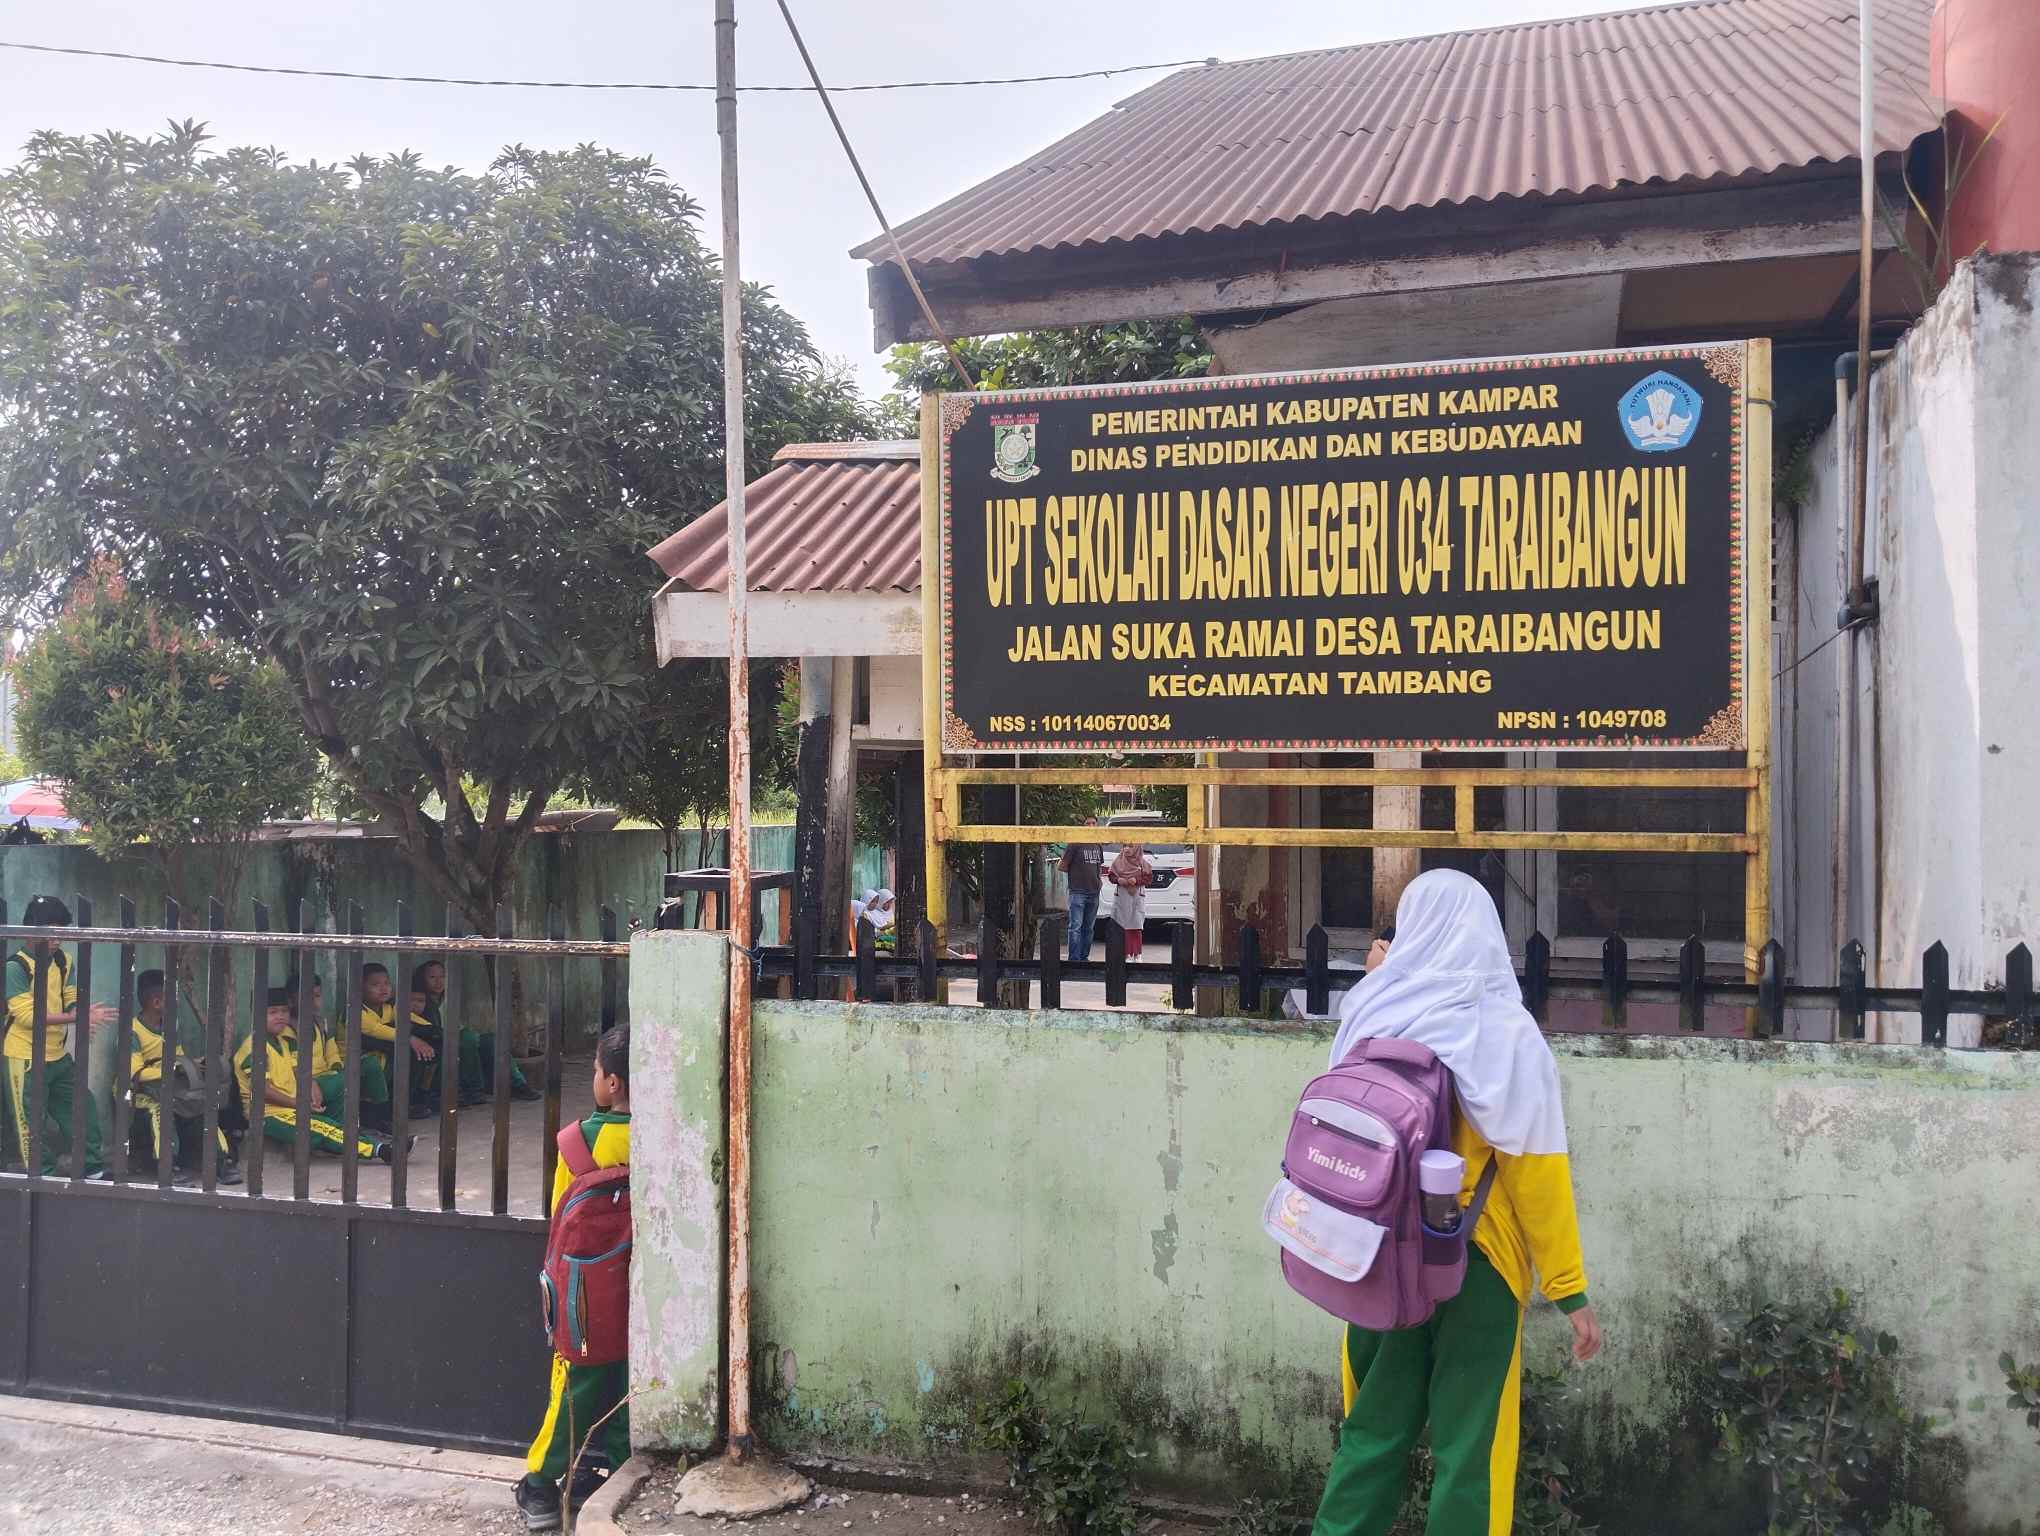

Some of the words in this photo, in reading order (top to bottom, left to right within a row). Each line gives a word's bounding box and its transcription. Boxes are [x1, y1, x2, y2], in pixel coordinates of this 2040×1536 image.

[1092, 403, 1257, 435] PEMERINTAH
[1267, 392, 1429, 426] KABUPATEN
[1439, 384, 1558, 415] KAMPAR
[1071, 445, 1147, 472] DINAS
[1156, 435, 1317, 467] PENDIDIKAN
[1326, 431, 1382, 459] DAN
[1392, 420, 1582, 454] KEBUDAYAAN
[986, 498, 1037, 607] UPT
[1045, 492, 1170, 605] SEKOLAH
[1180, 487, 1272, 600] DASAR
[1280, 481, 1389, 597] NEGERI
[1398, 476, 1451, 595] 034
[1460, 466, 1687, 591] TARAIBANGUN
[1008, 624, 1102, 662] JALAN
[1112, 622, 1197, 660] SUKA
[1206, 618, 1304, 657] RAMAI
[1316, 616, 1402, 655] DESA
[1411, 610, 1661, 653] TARAIBANGUN
[1149, 672, 1328, 697] KECAMATAN
[1338, 669, 1492, 694] TAMBANG
[990, 715, 1026, 732] NSS
[1041, 714, 1172, 731] 101140670034
[1497, 711, 1557, 729] NPSN
[1576, 710, 1667, 728] 1049708
